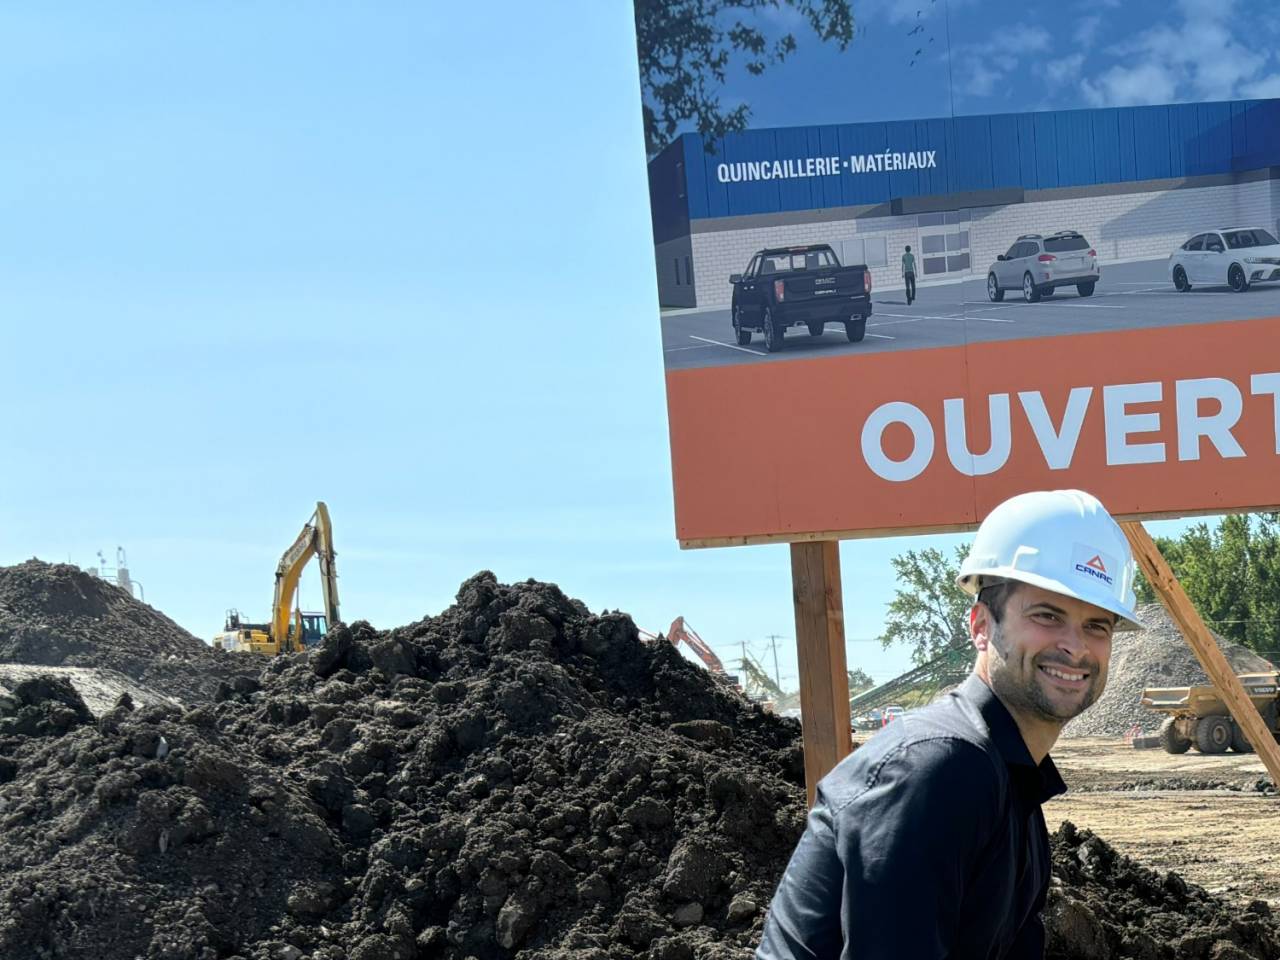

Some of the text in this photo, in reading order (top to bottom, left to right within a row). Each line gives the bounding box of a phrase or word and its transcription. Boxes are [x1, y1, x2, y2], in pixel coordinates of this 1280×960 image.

[717, 148, 937, 183] QUINCAILLERIE MATÉRIAUX
[1075, 563, 1113, 585] CANAC
